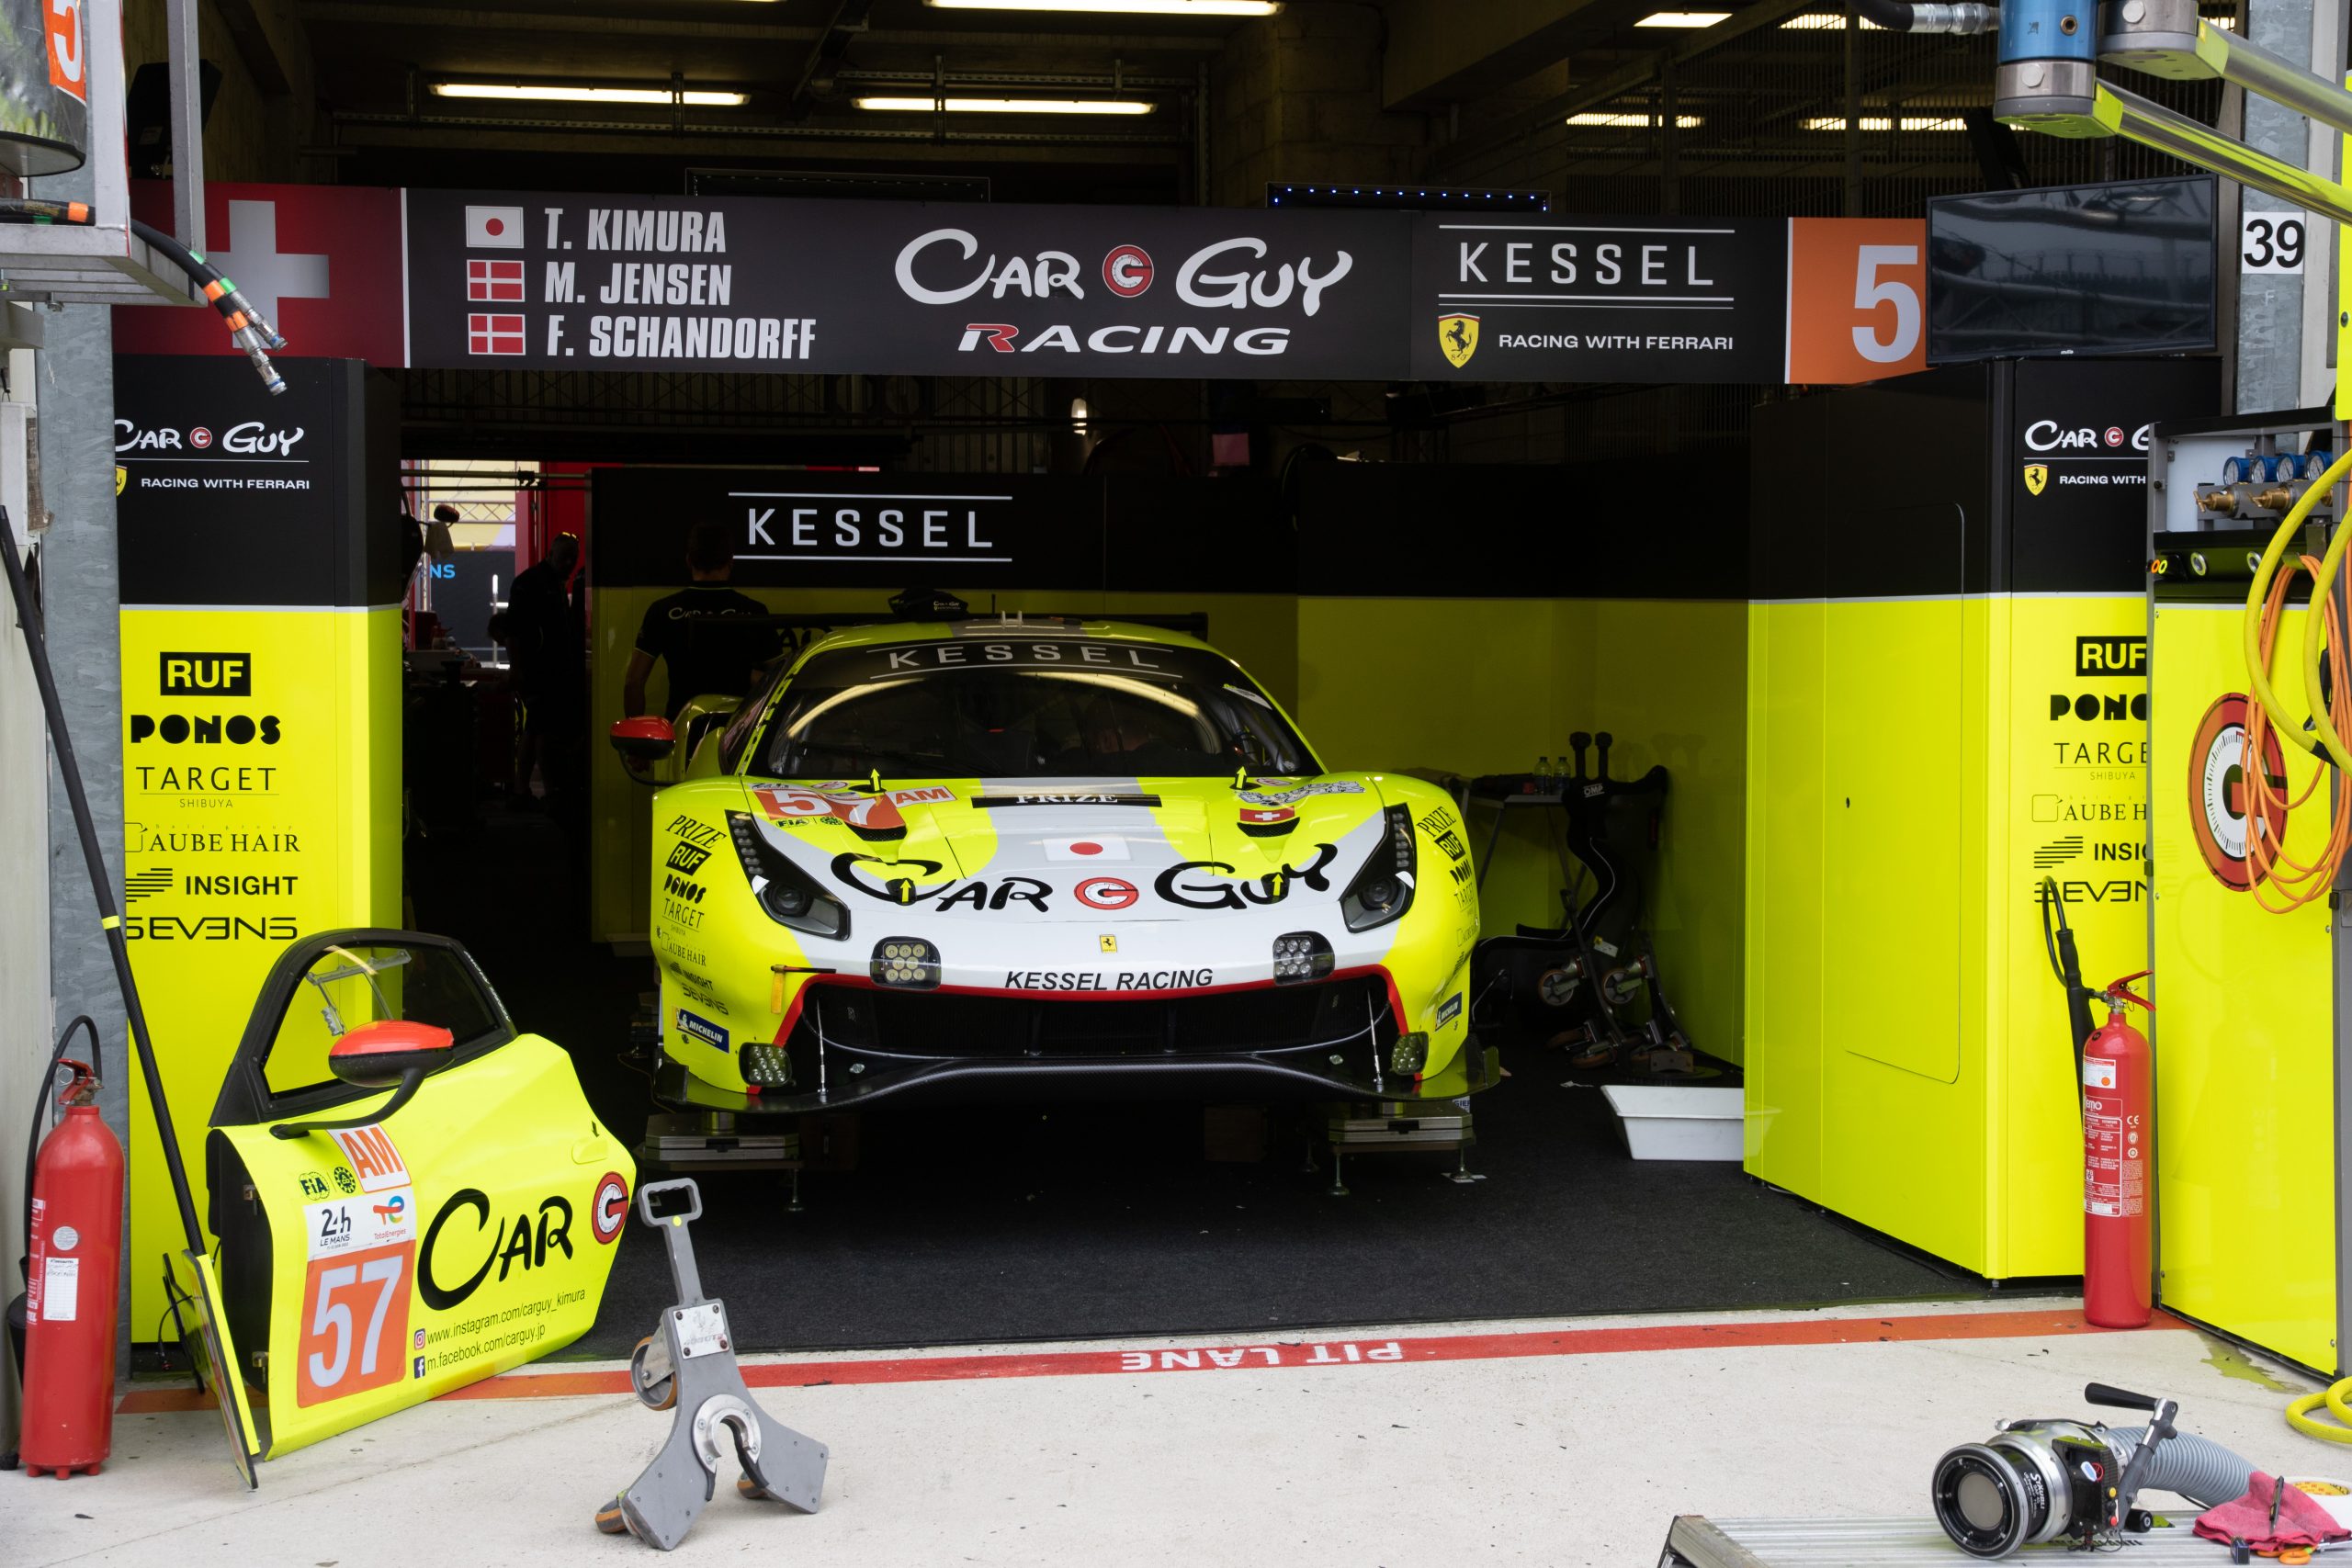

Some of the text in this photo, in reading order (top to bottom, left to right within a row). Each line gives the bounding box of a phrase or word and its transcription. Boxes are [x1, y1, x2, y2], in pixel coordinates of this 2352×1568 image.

[545, 208, 726, 253] T. KIMURA
[2244, 219, 2304, 268] 39
[895, 228, 1085, 305] CAR
[1175, 237, 1353, 317] GUY
[1459, 242, 1714, 286] KESSEL
[545, 261, 731, 306] M. JENSEN
[1851, 244, 1921, 364] 5
[547, 315, 816, 359] F. SCHANDORFF
[957, 323, 1292, 355] RACING
[1498, 334, 1733, 350] RACING WITH FERRARI
[222, 422, 304, 457] GUY
[2024, 420, 2098, 451] CAR
[141, 478, 310, 490] RACING WITH FERRARI
[2059, 475, 2146, 485] RACING WITH
[749, 508, 993, 547] KESSEL
[889, 644, 1159, 670] KESSEL
[2082, 643, 2146, 670] RUF
[167, 660, 243, 688] RUF
[130, 714, 281, 745] PONOS
[136, 766, 277, 791] TARGET
[1583, 784, 1605, 796] OMP
[2090, 772, 2136, 780] SHIBUYA
[179, 798, 233, 808] SHIBUYA
[772, 787, 950, 826] 57 AM
[1016, 794, 1118, 804] PRIZE
[665, 815, 727, 849] PRIZE
[777, 818, 808, 827] FIA
[1416, 806, 1457, 838] PRIZE
[231, 833, 301, 852] HAIR
[1439, 834, 1462, 858] RUF
[2094, 842, 2147, 861] INSI
[671, 845, 707, 871] RUF
[186, 875, 299, 896] INSIGHT
[664, 874, 707, 904] PONOS
[831, 852, 1054, 913] CAR
[1154, 842, 1338, 909] GUY
[2034, 880, 2148, 903] SEVE
[664, 897, 705, 930] TARGET
[687, 948, 707, 966] HAIR
[683, 970, 714, 991] INSIGHT
[1004, 968, 1214, 991] KESSEL RACING
[688, 1020, 723, 1043] MICHELIN
[2127, 1115, 2140, 1125] CE
[339, 1126, 403, 1180] AM
[300, 1177, 328, 1195] FIA
[322, 1205, 352, 1237] 24h
[374, 1228, 407, 1240] TotalEnergies
[320, 1237, 330, 1247] LE
[330, 1234, 350, 1245] MANS
[417, 1188, 574, 1311] CAR
[309, 1254, 403, 1388] 57
[427, 1287, 586, 1346] www.instagram.com/carguy_kimura
[427, 1323, 546, 1371] m.facebook.com/carguy.jp
[1121, 1342, 1404, 1371] PIT LANE
